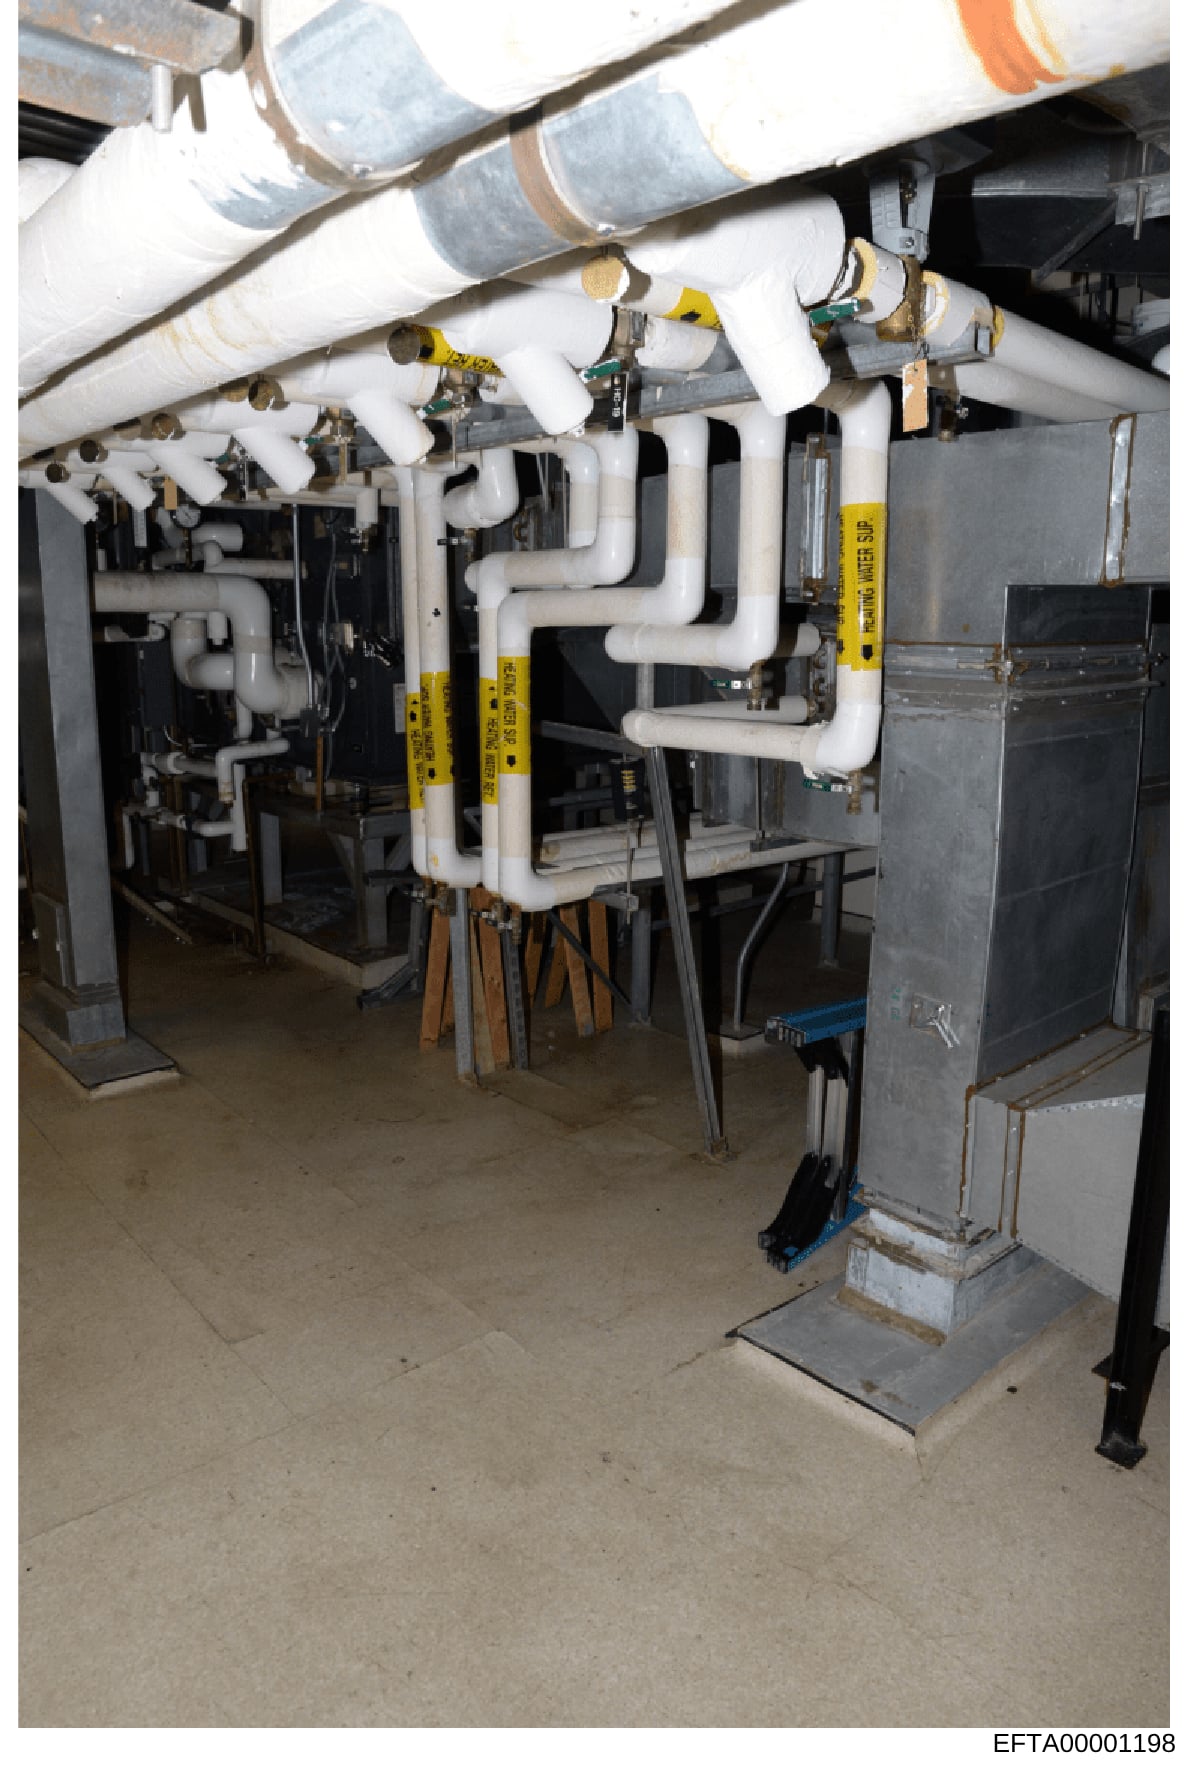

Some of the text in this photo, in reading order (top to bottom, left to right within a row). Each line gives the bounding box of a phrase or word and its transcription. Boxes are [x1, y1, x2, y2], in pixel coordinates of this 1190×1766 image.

[857, 517, 876, 633] HEATING WATER SUP.
[504, 662, 517, 747] HEATING WATER SUP.
[486, 718, 499, 750] HEATING
[484, 754, 496, 780] WATER
